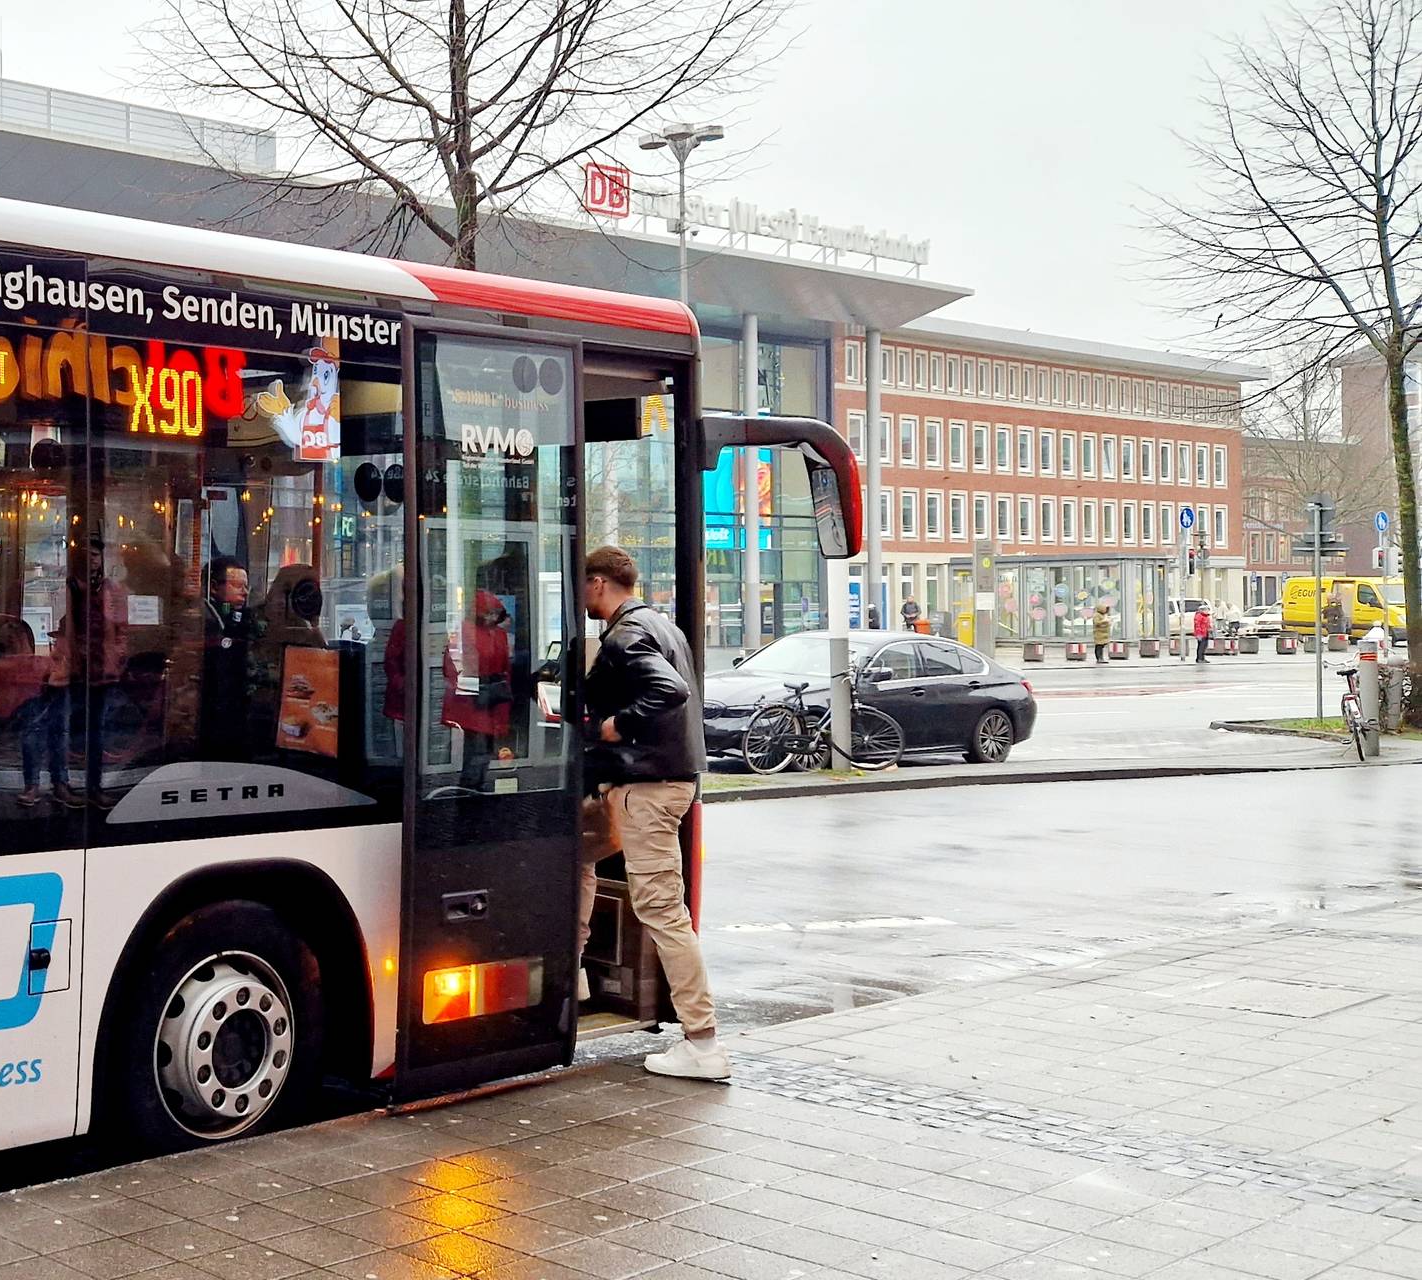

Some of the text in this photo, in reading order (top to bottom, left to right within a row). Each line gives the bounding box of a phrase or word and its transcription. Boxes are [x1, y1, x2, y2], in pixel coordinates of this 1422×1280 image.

[590, 170, 625, 209] DB
[162, 285, 283, 339] Senden,
[290, 301, 403, 346] Münster
[129, 364, 203, 436] X90
[161, 783, 284, 805] SETRA
